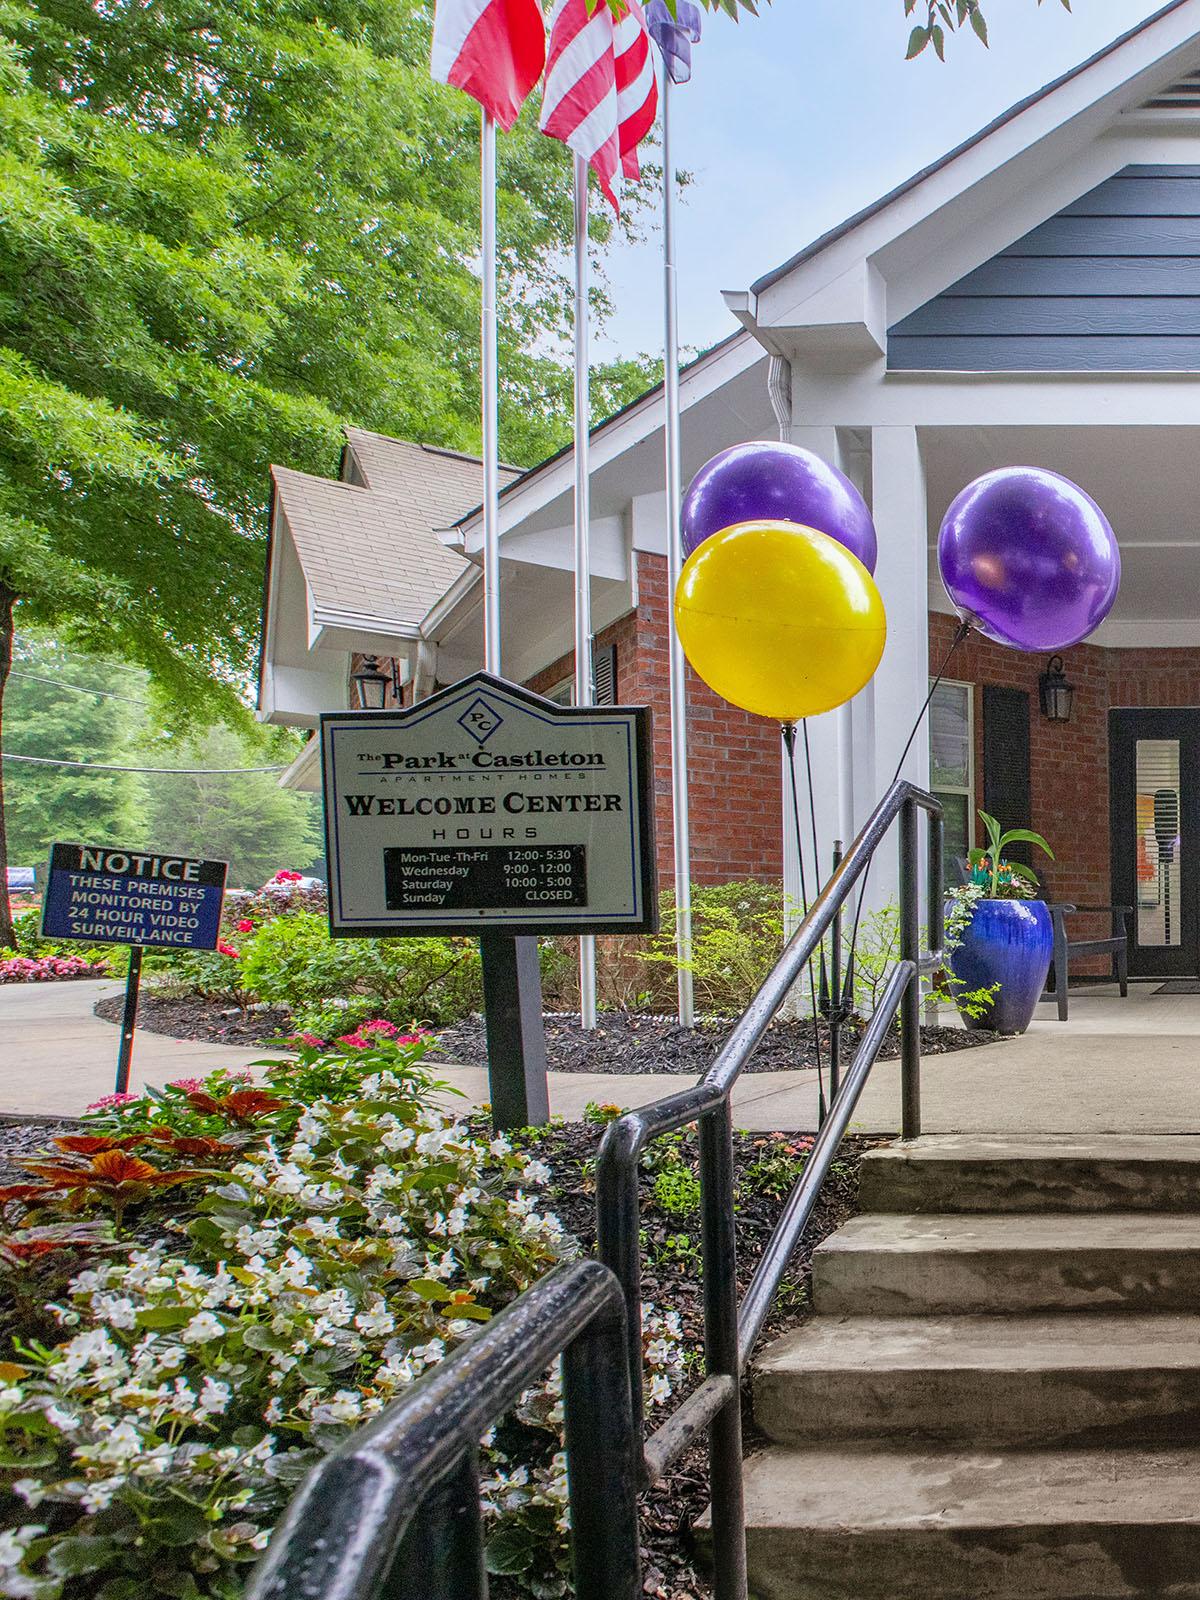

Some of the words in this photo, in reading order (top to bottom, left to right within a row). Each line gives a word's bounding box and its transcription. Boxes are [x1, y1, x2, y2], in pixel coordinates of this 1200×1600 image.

[381, 751, 457, 769] Park
[458, 752, 470, 761] at
[472, 750, 606, 768] Castleton
[380, 774, 505, 783] APARTMENT
[519, 772, 587, 781] HOMES
[344, 794, 496, 816] WELCOME
[503, 791, 623, 813] CENTER
[433, 827, 538, 840] HOURS
[80, 849, 200, 882] NOTICE
[401, 866, 470, 878] Wednesday
[503, 864, 529, 874] 9:00
[540, 863, 571, 873] 12:00
[69, 874, 122, 891] THESE
[127, 881, 206, 900] PREMISES
[402, 879, 453, 891] Saturday
[505, 877, 537, 888] 10:00
[547, 876, 572, 887] 5:00
[72, 891, 173, 912] MONITORED
[179, 902, 200, 914] BY
[403, 893, 446, 905] Sunday
[525, 890, 572, 901] CLOSED
[68, 906, 89, 918] 24
[95, 910, 144, 923] HOUR
[150, 914, 200, 929] VIDEO
[71, 921, 193, 943] SURVEILLANCE
